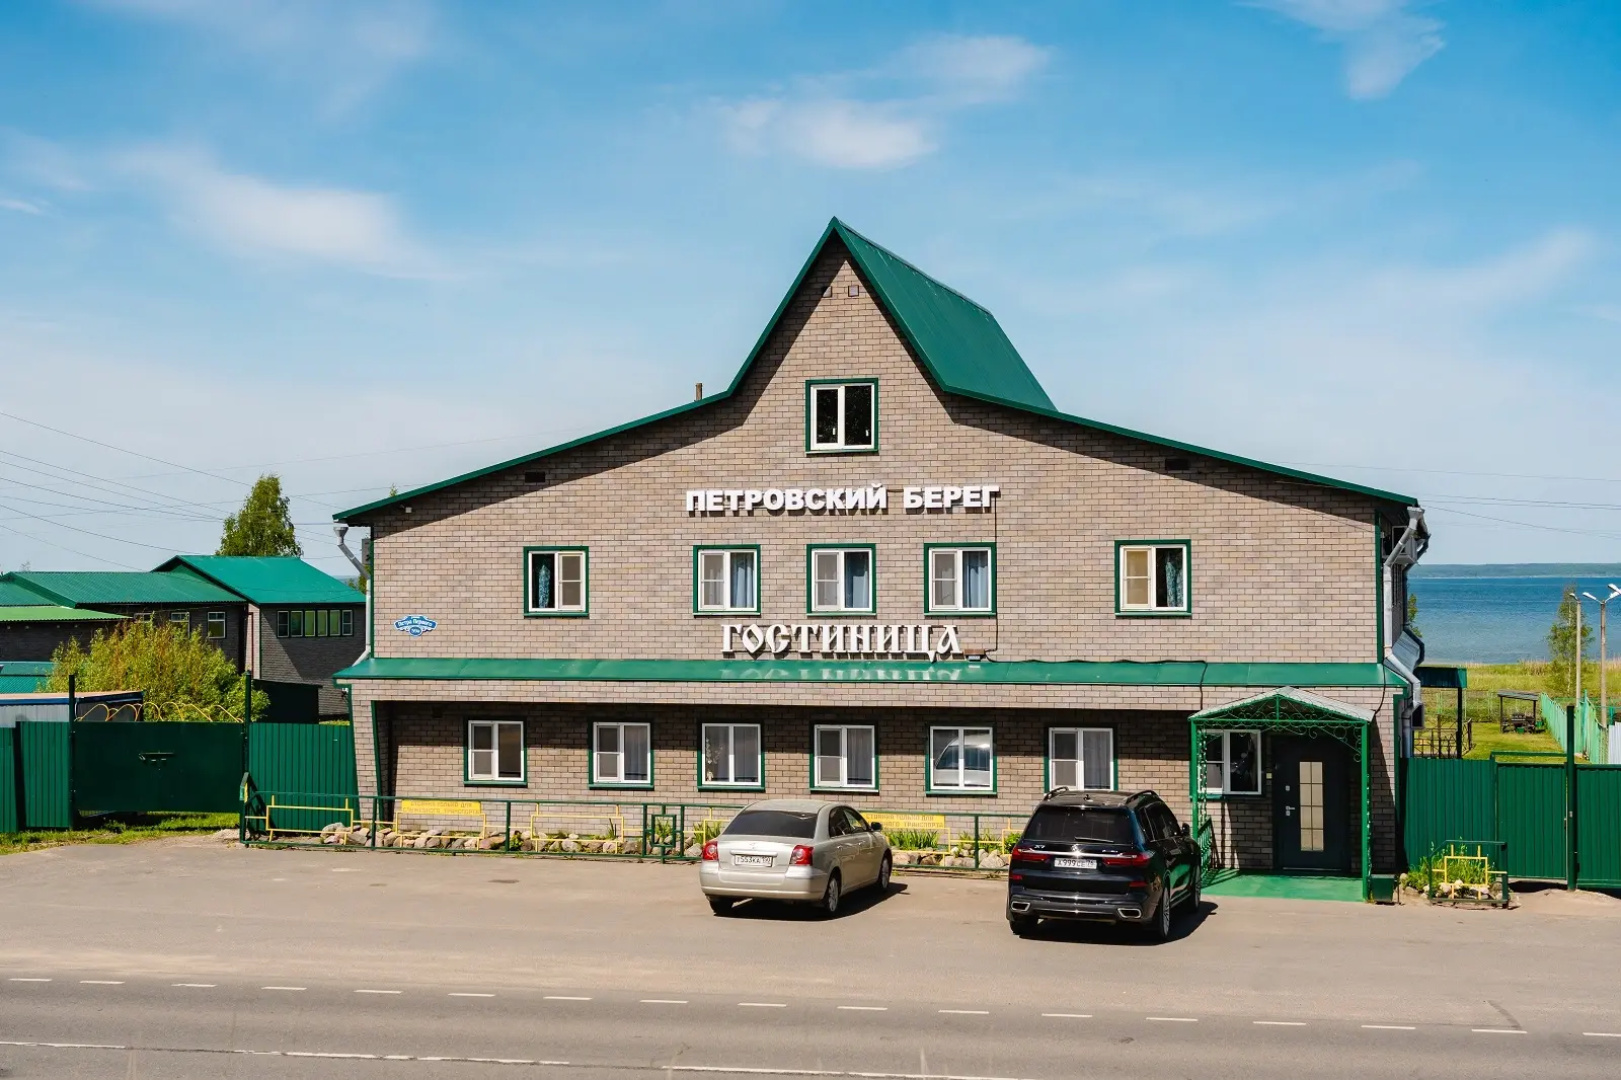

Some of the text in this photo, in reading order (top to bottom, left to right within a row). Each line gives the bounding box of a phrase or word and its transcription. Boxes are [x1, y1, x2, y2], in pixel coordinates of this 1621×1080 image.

[686, 482, 1000, 512] ПЕТРОВСКИЙ БЕРЕГ
[720, 623, 963, 663] ГОСТИНИЦА
